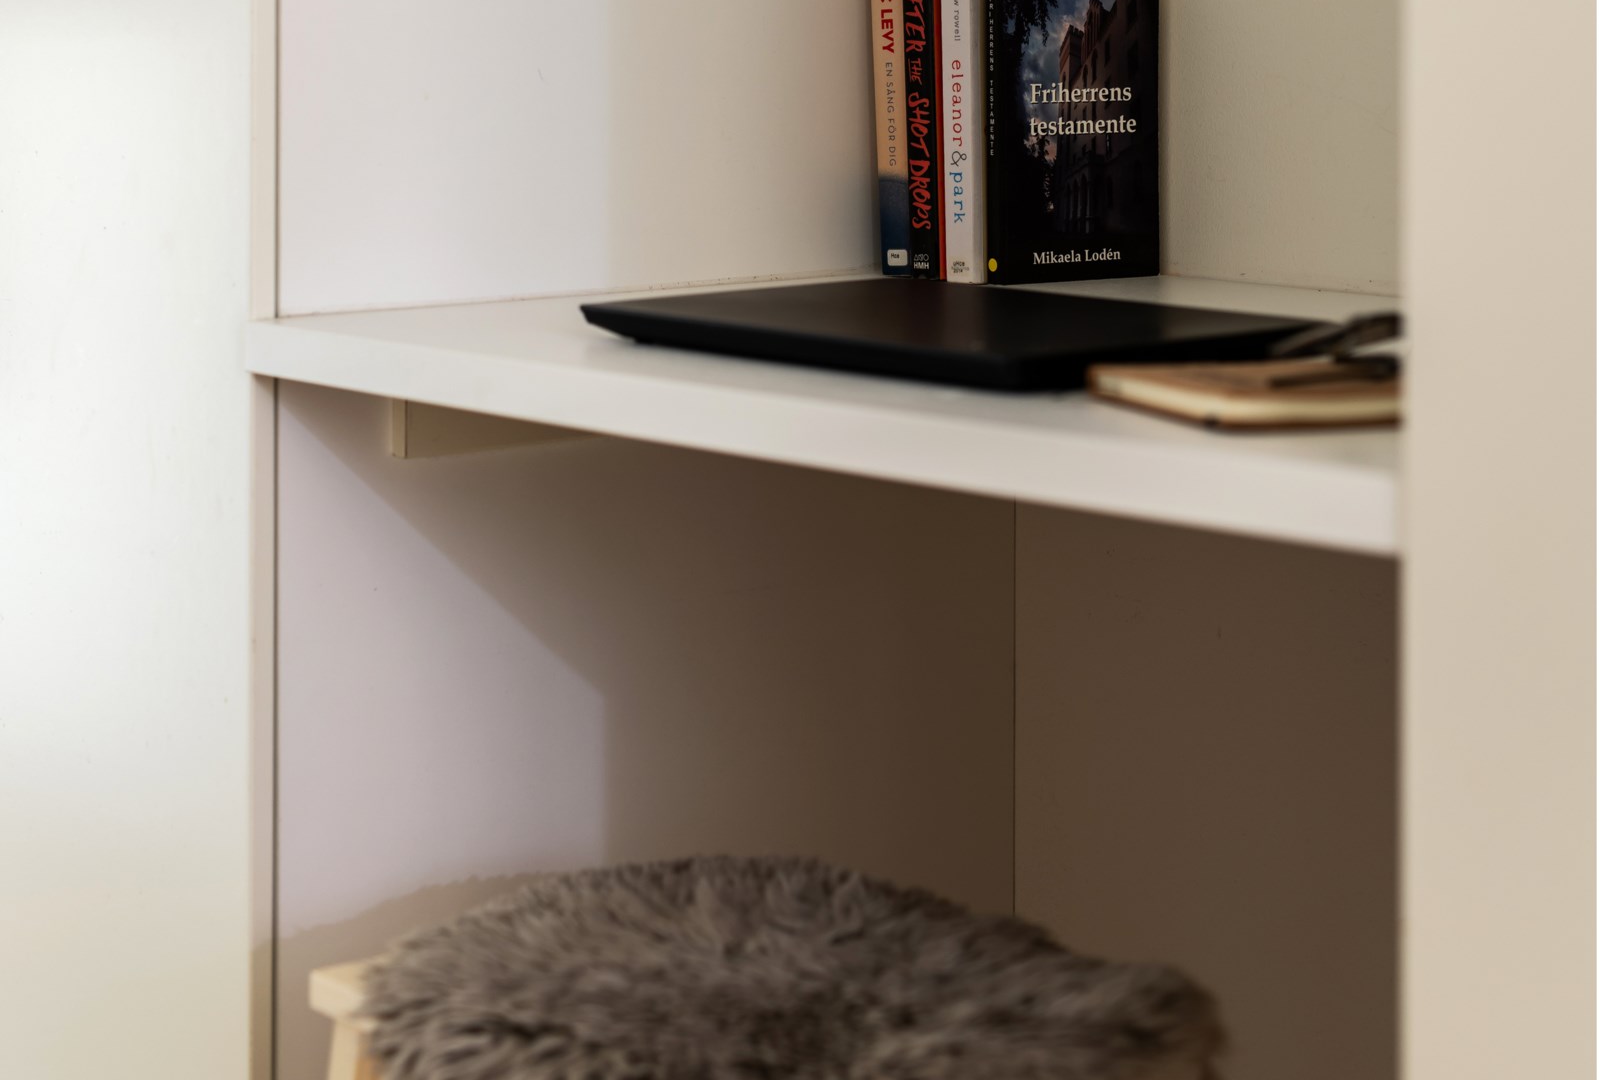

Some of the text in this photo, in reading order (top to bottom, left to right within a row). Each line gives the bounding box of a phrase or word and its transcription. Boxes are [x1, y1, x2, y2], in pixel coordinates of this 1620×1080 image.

[880, 9, 895, 54] LEVY
[953, 10, 961, 41] rowell
[909, 58, 923, 85] THE
[1030, 82, 1132, 103] Friherrens
[885, 62, 897, 166] EN SÅNG FÖR DIG
[908, 92, 930, 159] SHOT
[1029, 115, 1136, 135] testamente
[949, 59, 967, 223] eleanor & park
[908, 159, 931, 230] DROPS
[913, 261, 930, 270] HMH
[1033, 249, 1121, 264] Mikaela Lodén
